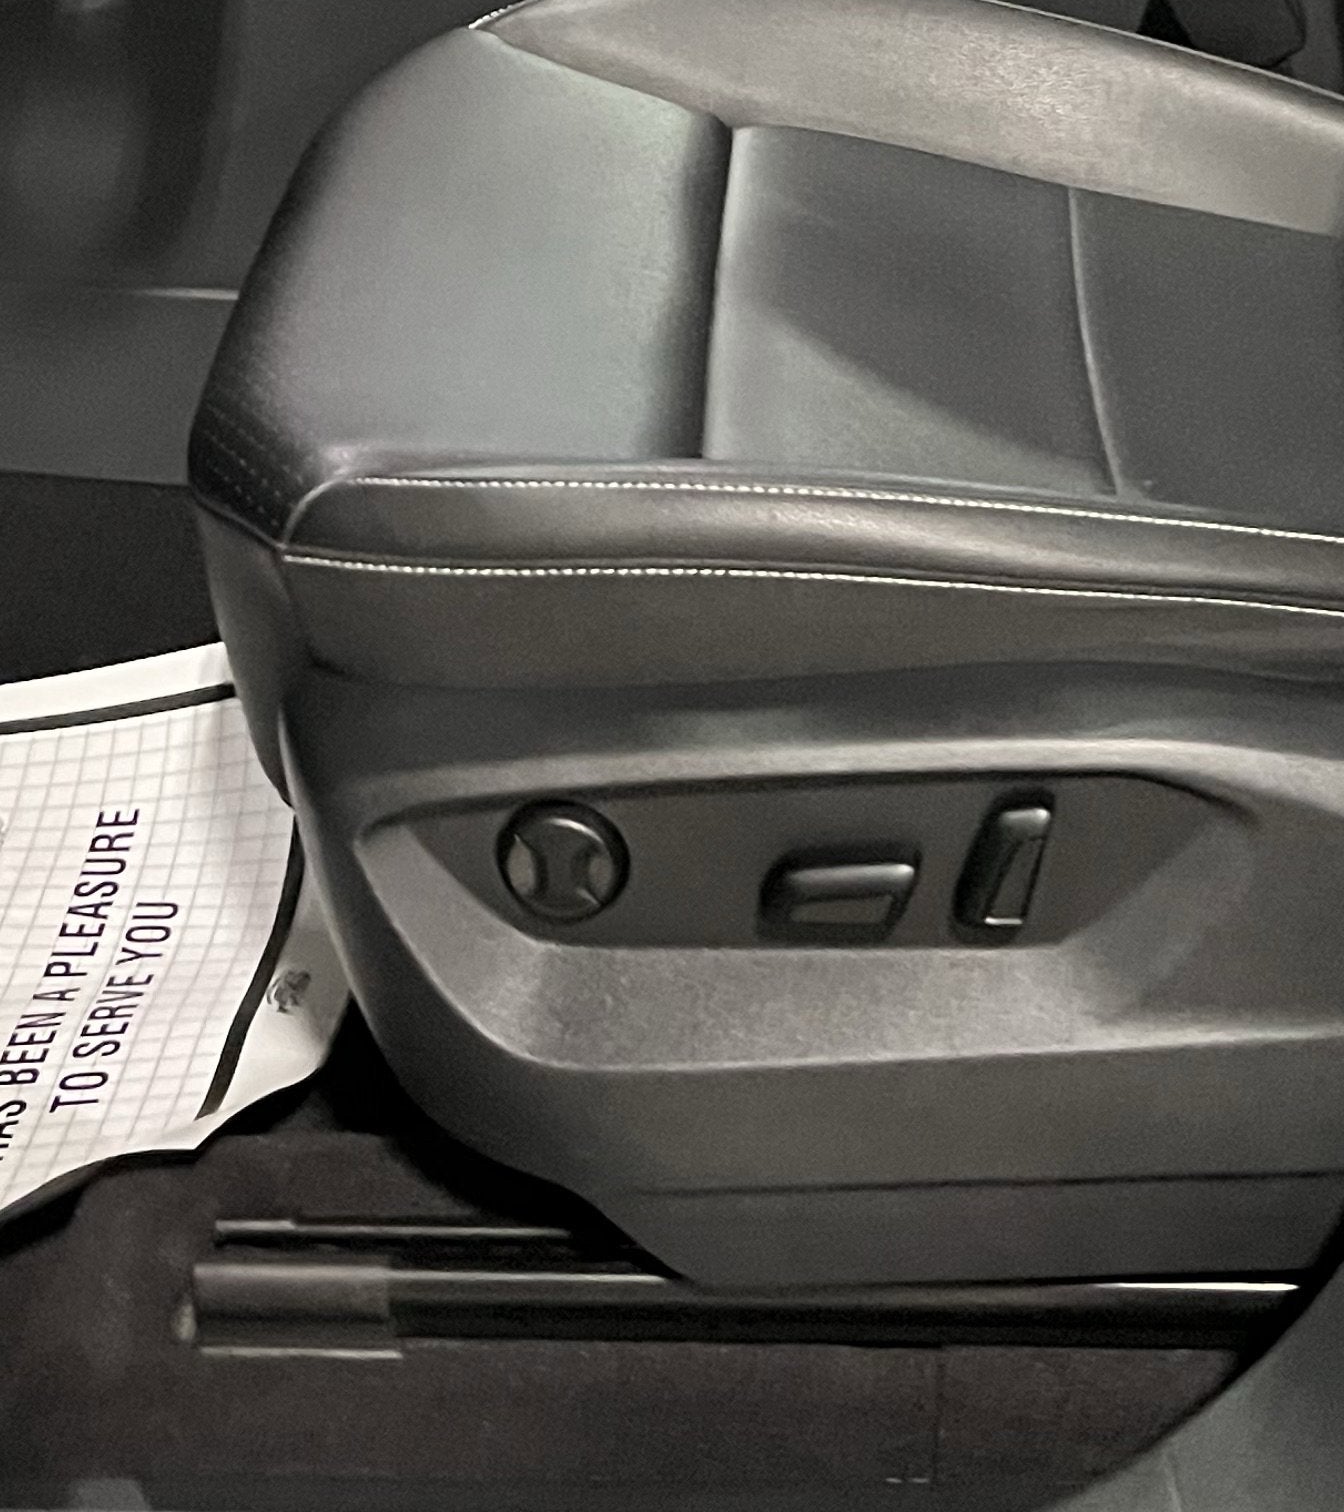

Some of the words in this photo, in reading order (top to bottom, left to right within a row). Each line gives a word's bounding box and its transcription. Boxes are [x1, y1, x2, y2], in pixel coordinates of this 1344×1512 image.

[43, 808, 140, 978] PLEASURE
[116, 900, 179, 966] YOU
[32, 987, 81, 1001] A
[72, 973, 154, 1058] SERVE
[49, 1071, 109, 1113] TO
